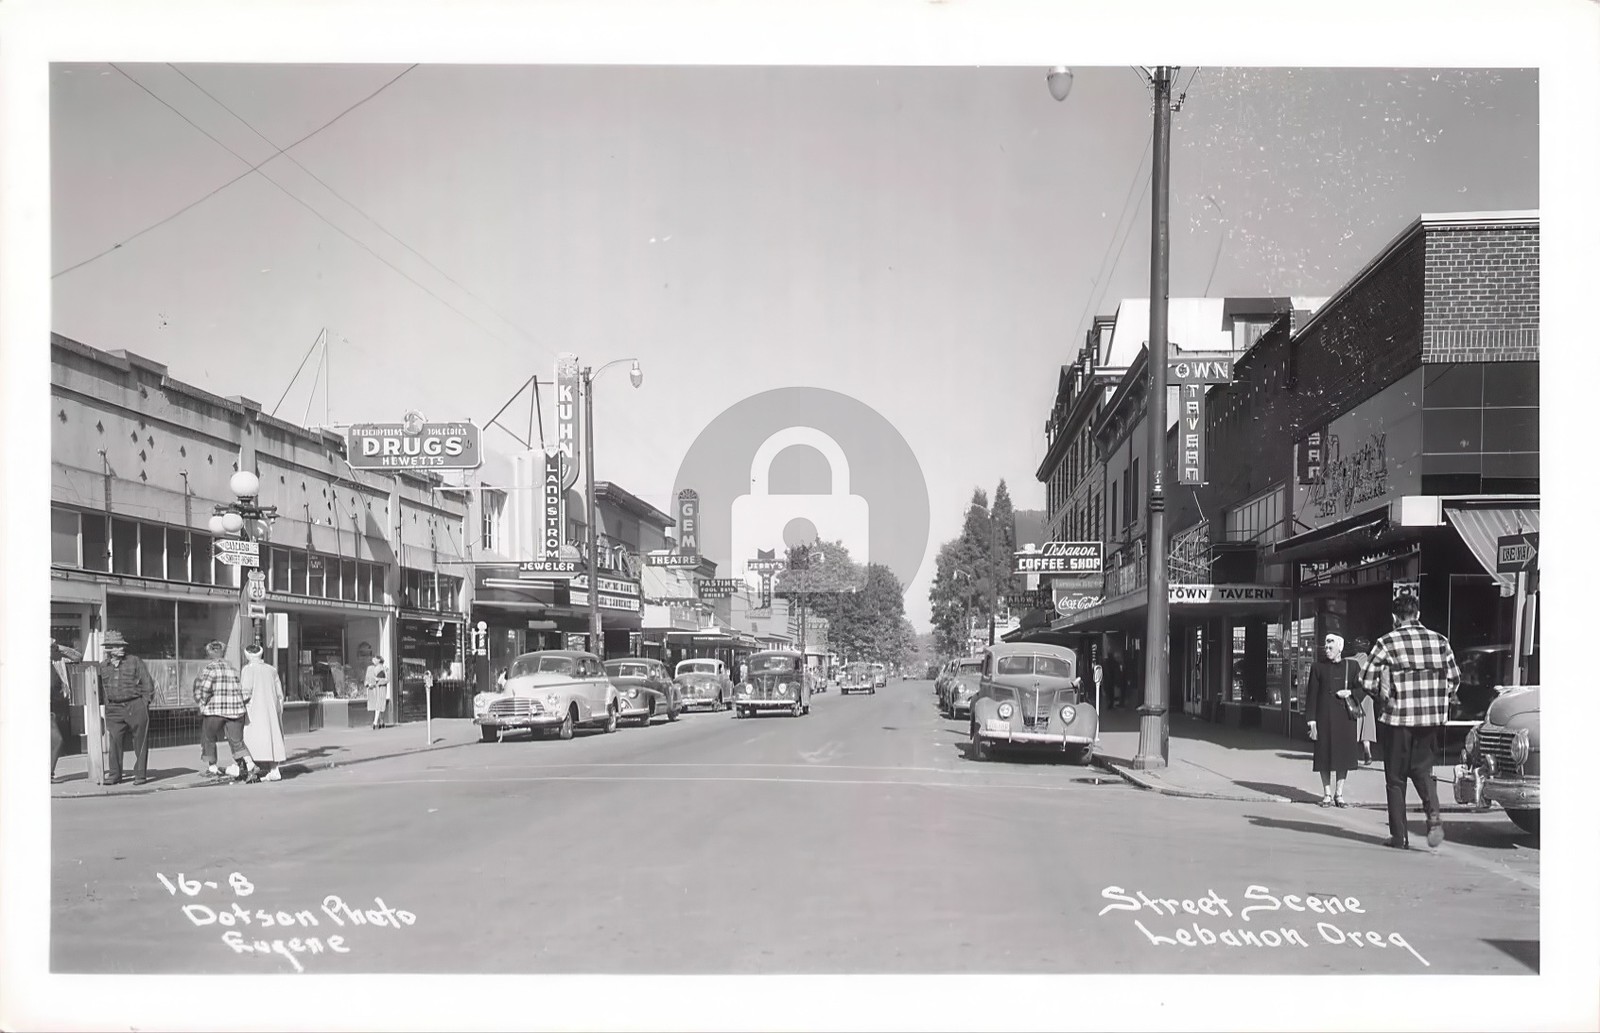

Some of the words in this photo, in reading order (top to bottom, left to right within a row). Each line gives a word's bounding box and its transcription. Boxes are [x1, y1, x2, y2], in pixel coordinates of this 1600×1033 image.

[1168, 361, 1229, 380] OWN
[559, 384, 573, 459] KUHN
[362, 436, 463, 456] DRUGS
[546, 463, 559, 559] LANDSTROM
[682, 503, 696, 548] GEM
[1044, 542, 1098, 557] Lebanon
[1502, 547, 1516, 562] ONE
[519, 562, 575, 571] JEWELER
[651, 556, 696, 565] THEATRE
[1018, 558, 1065, 570] COFFEE
[1069, 557, 1101, 569] SHOP
[1169, 589, 1207, 599] TOWN
[1219, 588, 1275, 600] TAVERN
